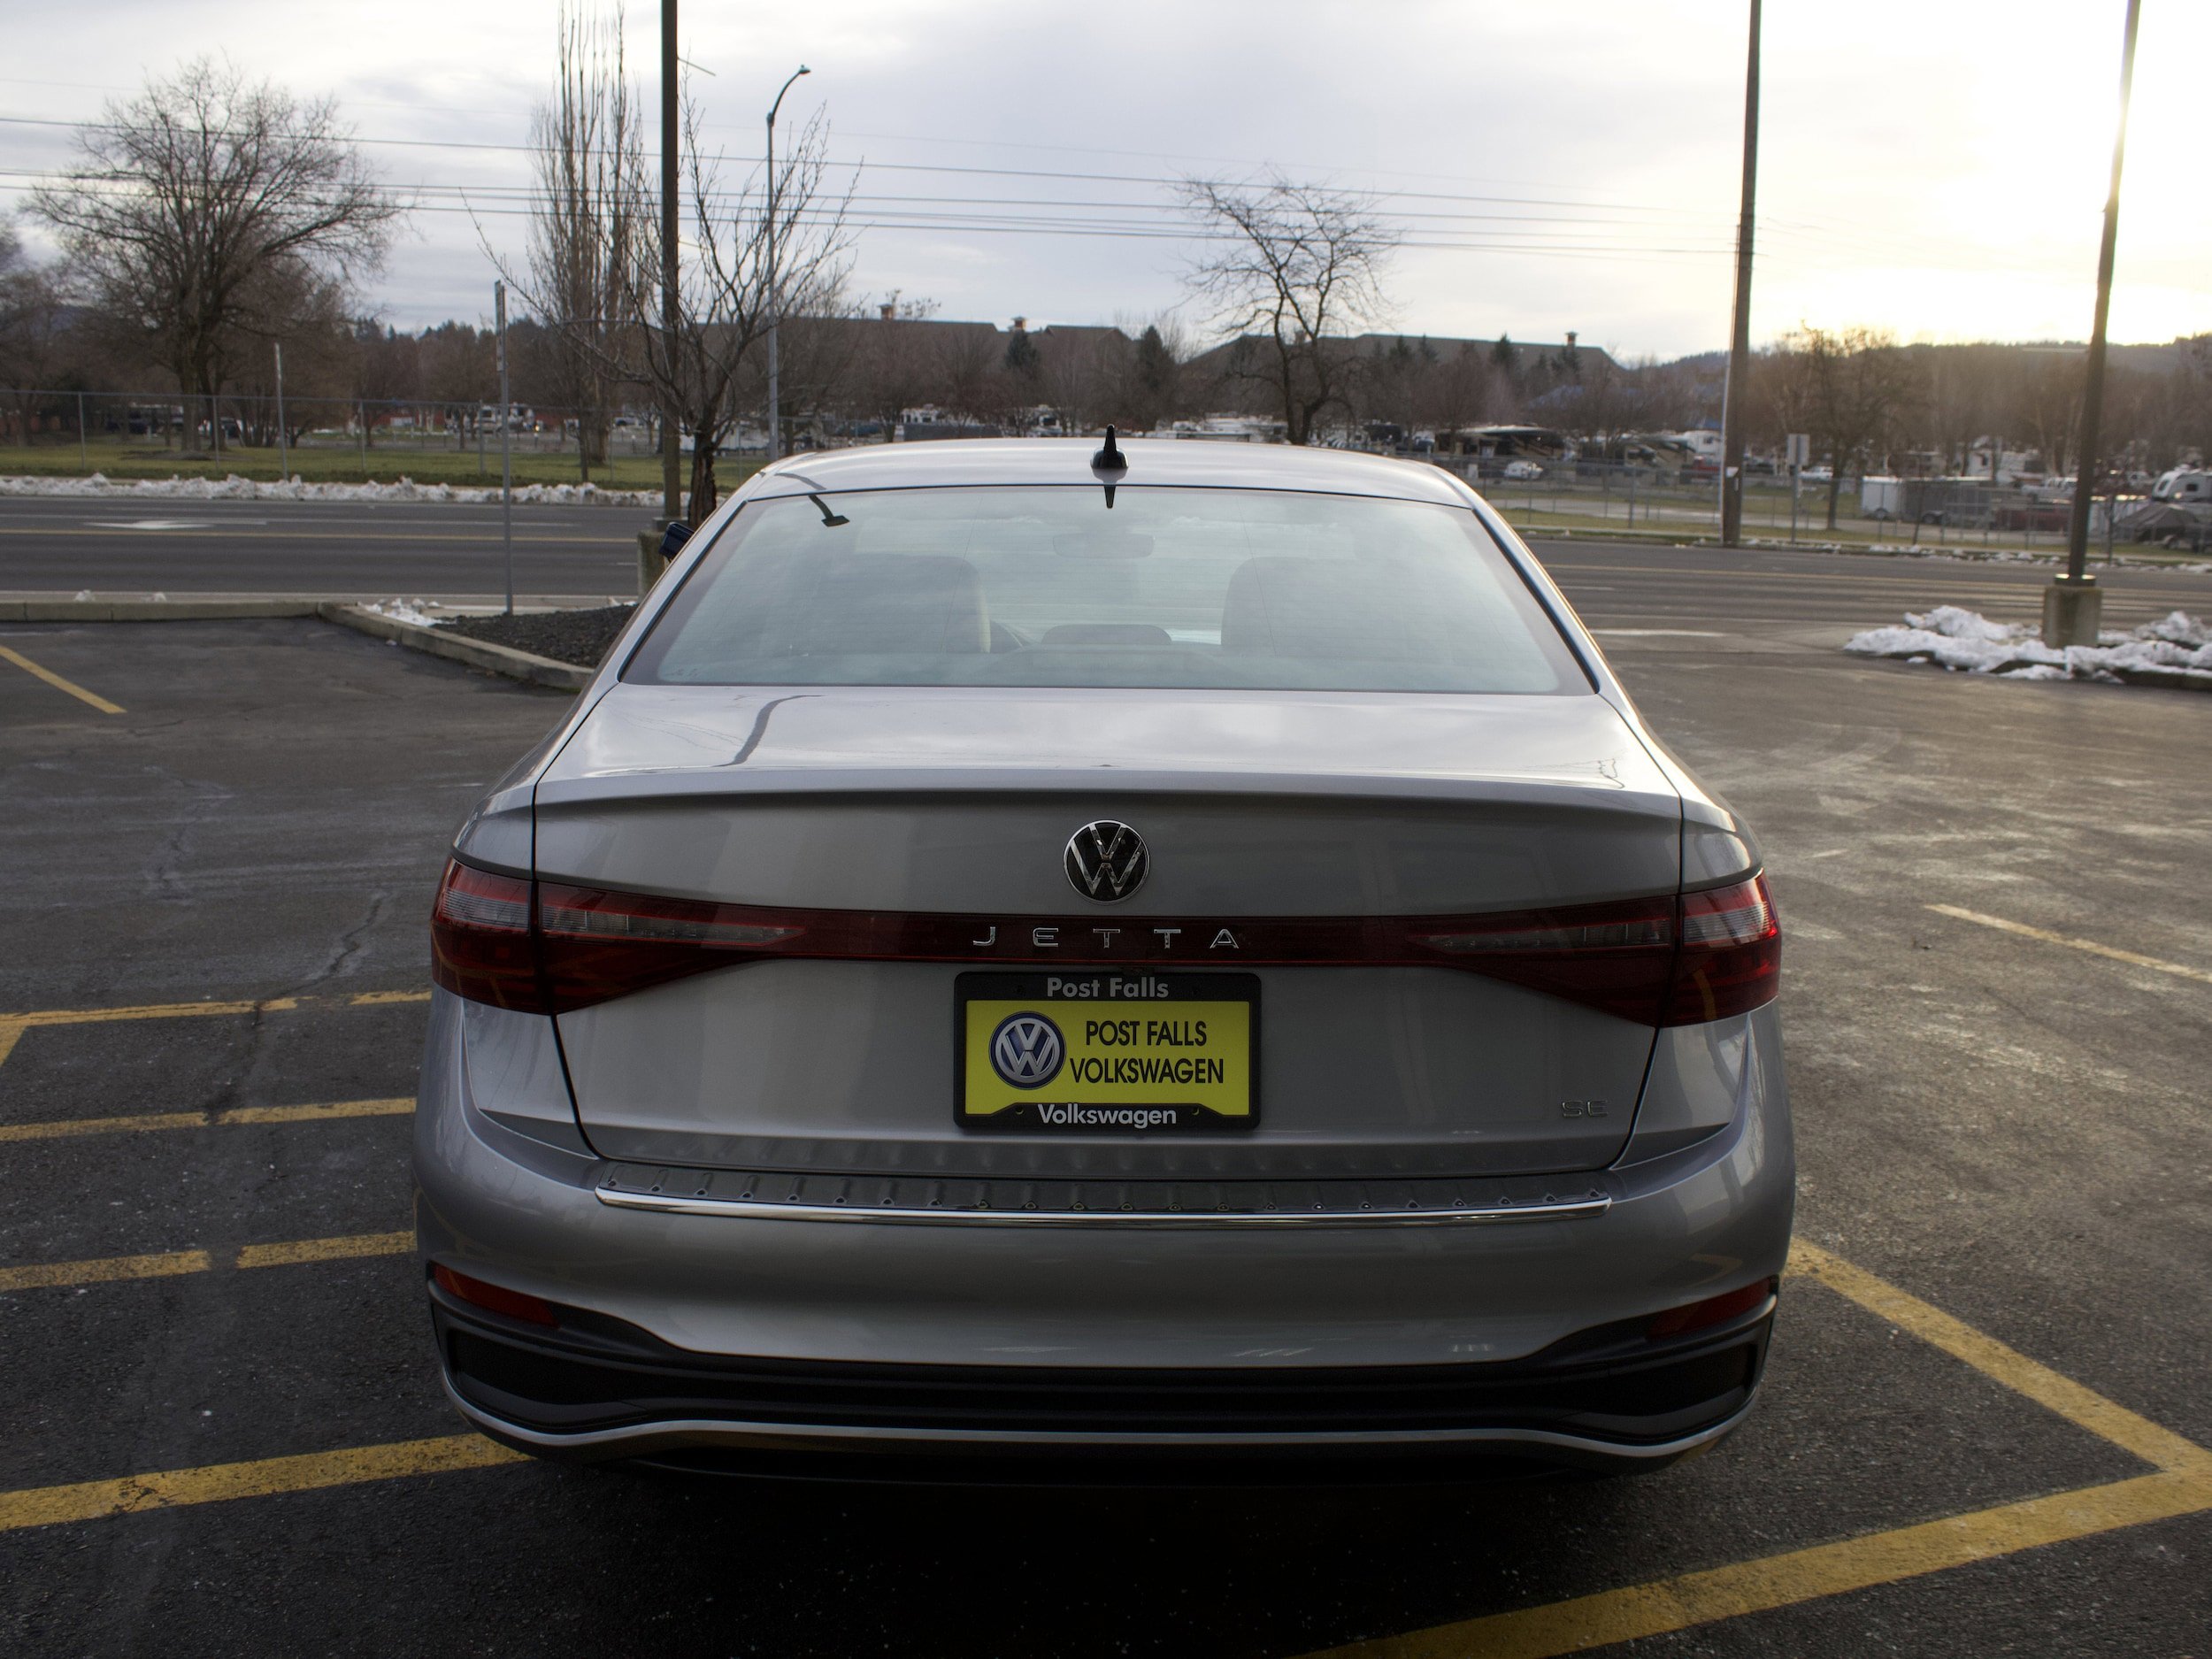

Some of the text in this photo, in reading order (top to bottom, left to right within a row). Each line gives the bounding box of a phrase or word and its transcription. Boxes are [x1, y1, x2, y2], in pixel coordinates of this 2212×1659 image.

[1064, 820, 1149, 903] VW
[972, 926, 1239, 949] JETTA
[1047, 977, 1169, 998] Post Falls
[1086, 1020, 1207, 1046] POST FALLS
[992, 1014, 1064, 1087] VW
[1070, 1057, 1224, 1084] VOLKSWAGEN
[1037, 1103, 1177, 1129] Volkswagen
[1562, 1100, 1609, 1118] SE
